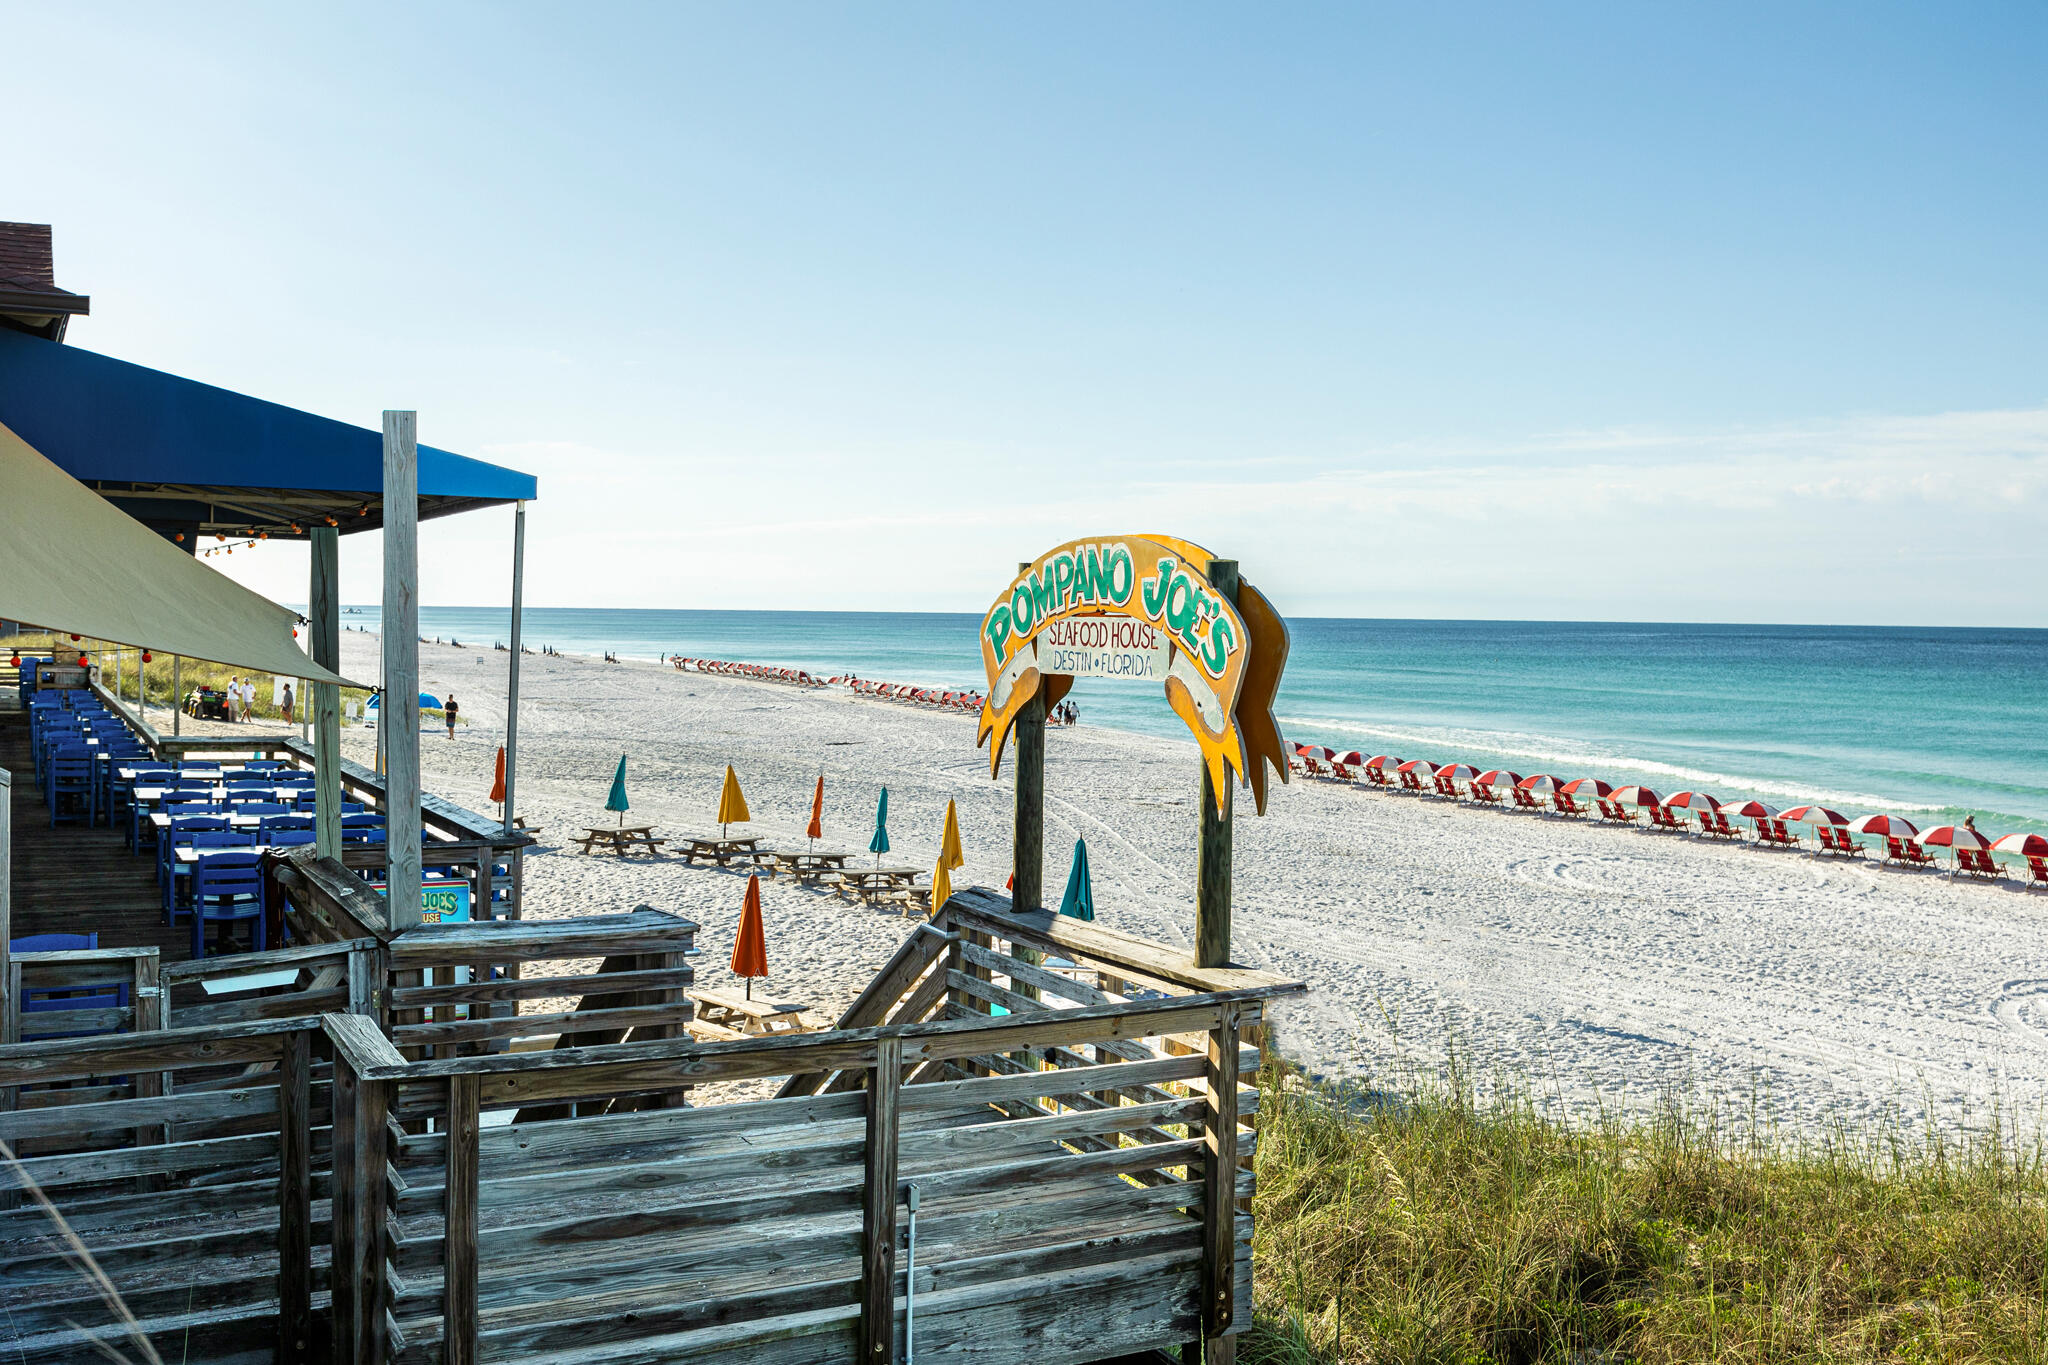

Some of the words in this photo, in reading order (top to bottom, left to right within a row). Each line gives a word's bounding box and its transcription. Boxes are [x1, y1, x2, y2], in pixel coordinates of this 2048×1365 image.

[985, 543, 1134, 669] POMPANO
[1142, 557, 1238, 679] JOE'S
[1049, 621, 1109, 648] SEAFOOD
[1112, 622, 1158, 650] HOUSE
[1054, 650, 1092, 672] DESTIN
[1101, 651, 1153, 676] FLORIDA
[421, 891, 457, 915] JOE'S
[423, 913, 440, 923] USE
